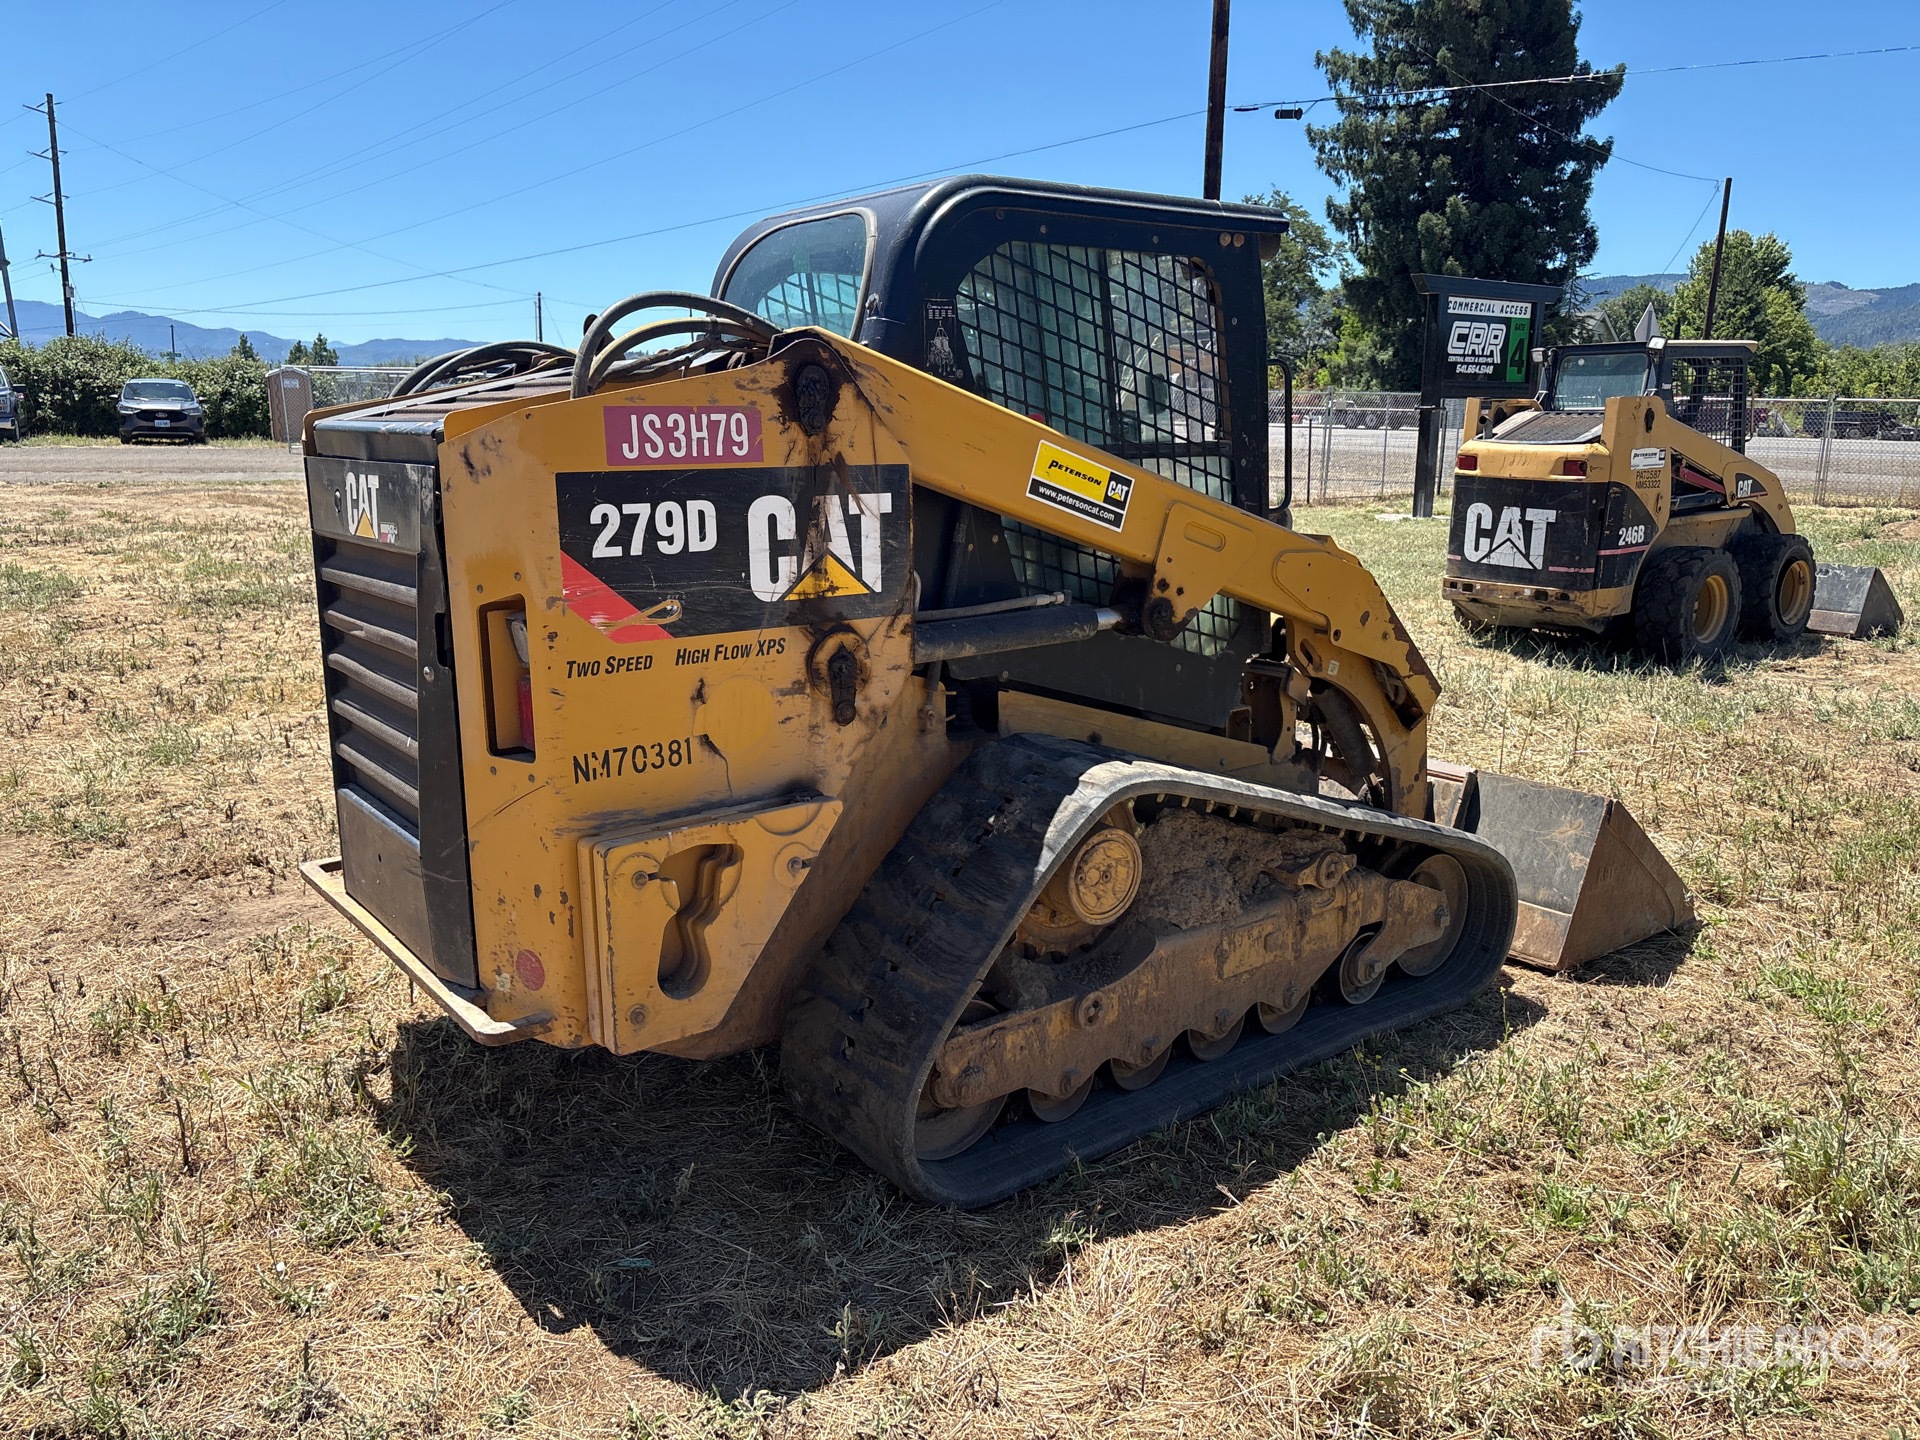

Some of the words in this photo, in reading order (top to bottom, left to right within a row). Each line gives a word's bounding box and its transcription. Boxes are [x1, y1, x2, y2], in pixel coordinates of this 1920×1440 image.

[1448, 301, 1495, 313] COMMERCIAL
[1500, 304, 1528, 316] ACCESS
[1447, 321, 1506, 363] CRR
[1509, 338, 1525, 374] 4
[622, 412, 749, 460] JS3H79
[1048, 460, 1102, 486] PETERSON
[1107, 480, 1129, 502] CAT
[1737, 479, 1753, 498] CAT
[345, 471, 380, 541] CAT
[1038, 485, 1115, 521] www.petersoncat.com
[589, 499, 718, 559] 279D
[1463, 502, 1557, 570] CAT
[1617, 524, 1645, 546] 246B
[747, 492, 893, 603] CAT
[755, 637, 787, 657] XPS
[572, 736, 693, 785] NM70381
